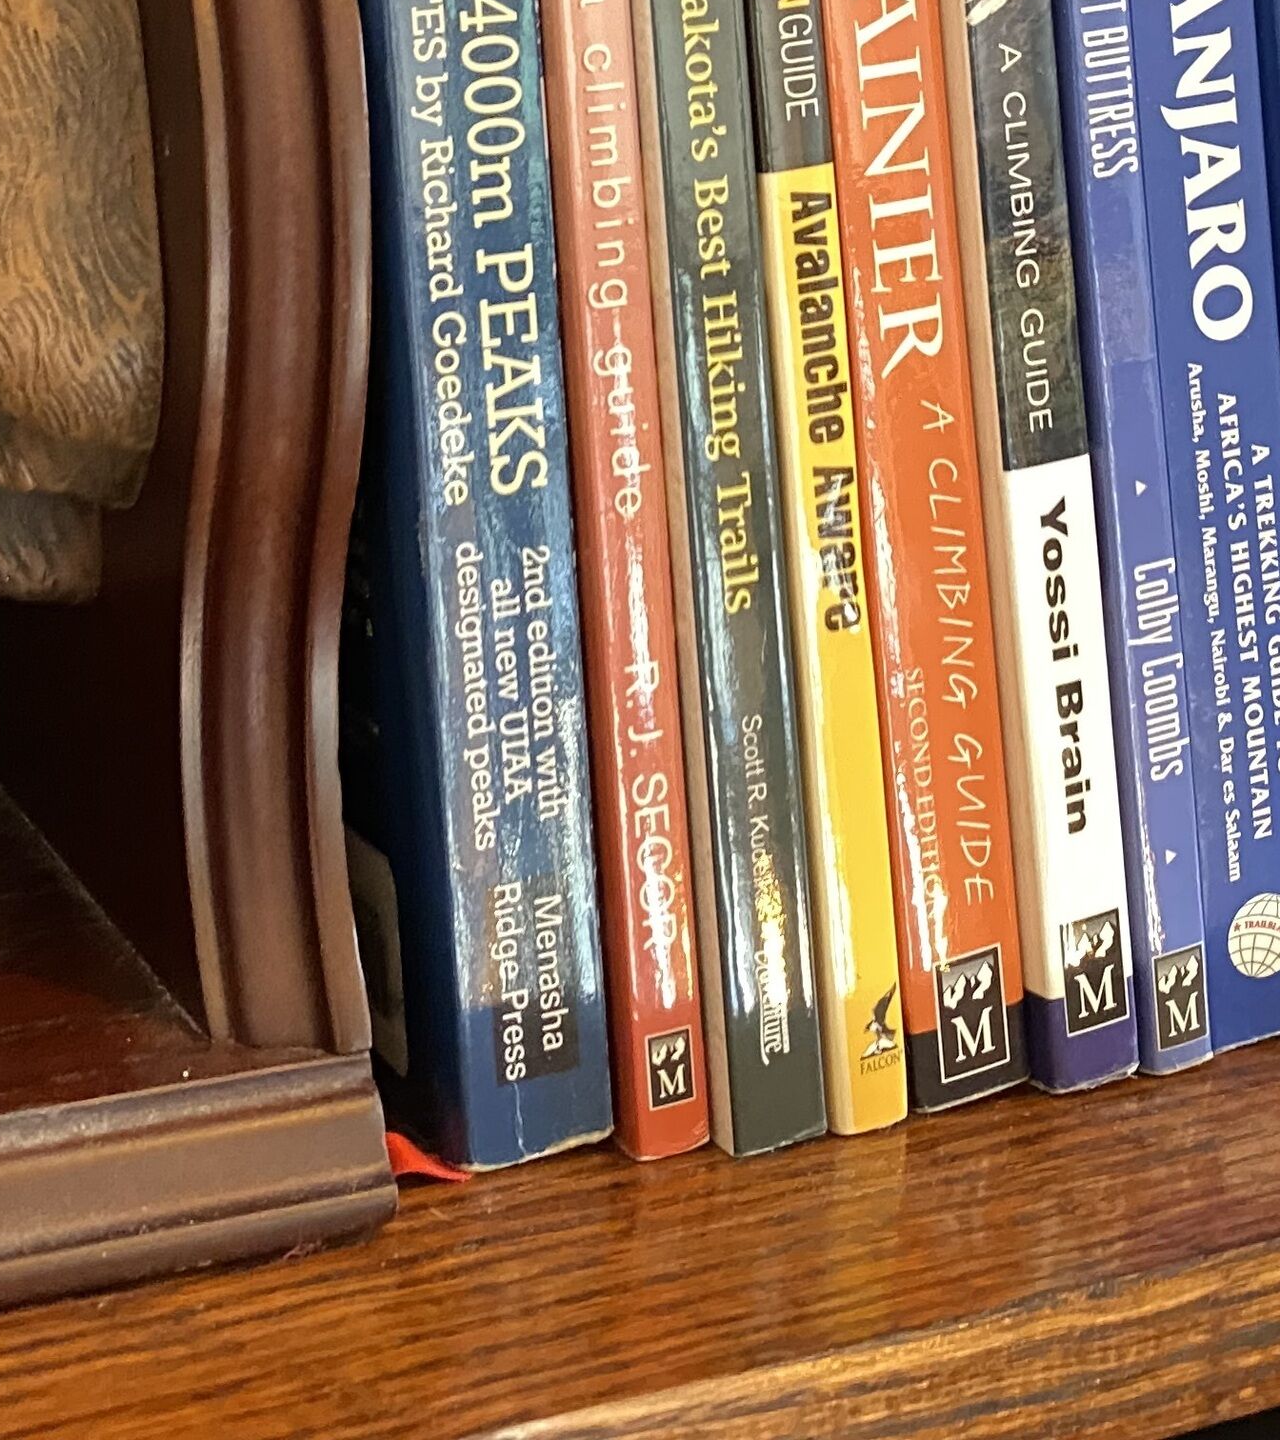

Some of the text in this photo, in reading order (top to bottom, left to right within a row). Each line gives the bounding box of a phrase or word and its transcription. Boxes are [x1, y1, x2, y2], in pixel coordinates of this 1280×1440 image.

[410, 72, 449, 126] by
[582, 46, 638, 309] climbing
[1080, 24, 1140, 180] BUTTRESS
[420, 136, 464, 303] Richard
[693, 173, 729, 281] Best
[998, 42, 1054, 434] A CLIMBING GUIDE
[431, 312, 477, 508] Goedeke
[475, 242, 550, 497] PEAKS
[702, 290, 746, 461] Hiking
[790, 190, 853, 446] Avalanche
[717, 470, 761, 614] Trails
[1251, 443, 1271, 467] A
[523, 545, 552, 613] 2nd
[921, 398, 995, 906] A CLIMBING GUIDE
[1039, 495, 1092, 835] Yossi Brain
[1127, 557, 1191, 783] Colby Coombs
[1186, 362, 1242, 883] Arusha, Moshi, Marangu, Nairobi & Dar es Salaam
[1216, 392, 1273, 841] AFRICA'S HIGHEST MOUNTAIN
[455, 541, 501, 851] designated peaks
[491, 578, 533, 805] all new UIAA
[536, 745, 569, 822] with
[905, 666, 934, 789] SECOND
[491, 881, 529, 1082] Ridge Press
[533, 893, 569, 1052] Menasha
[859, 1053, 901, 1076] FALCON
